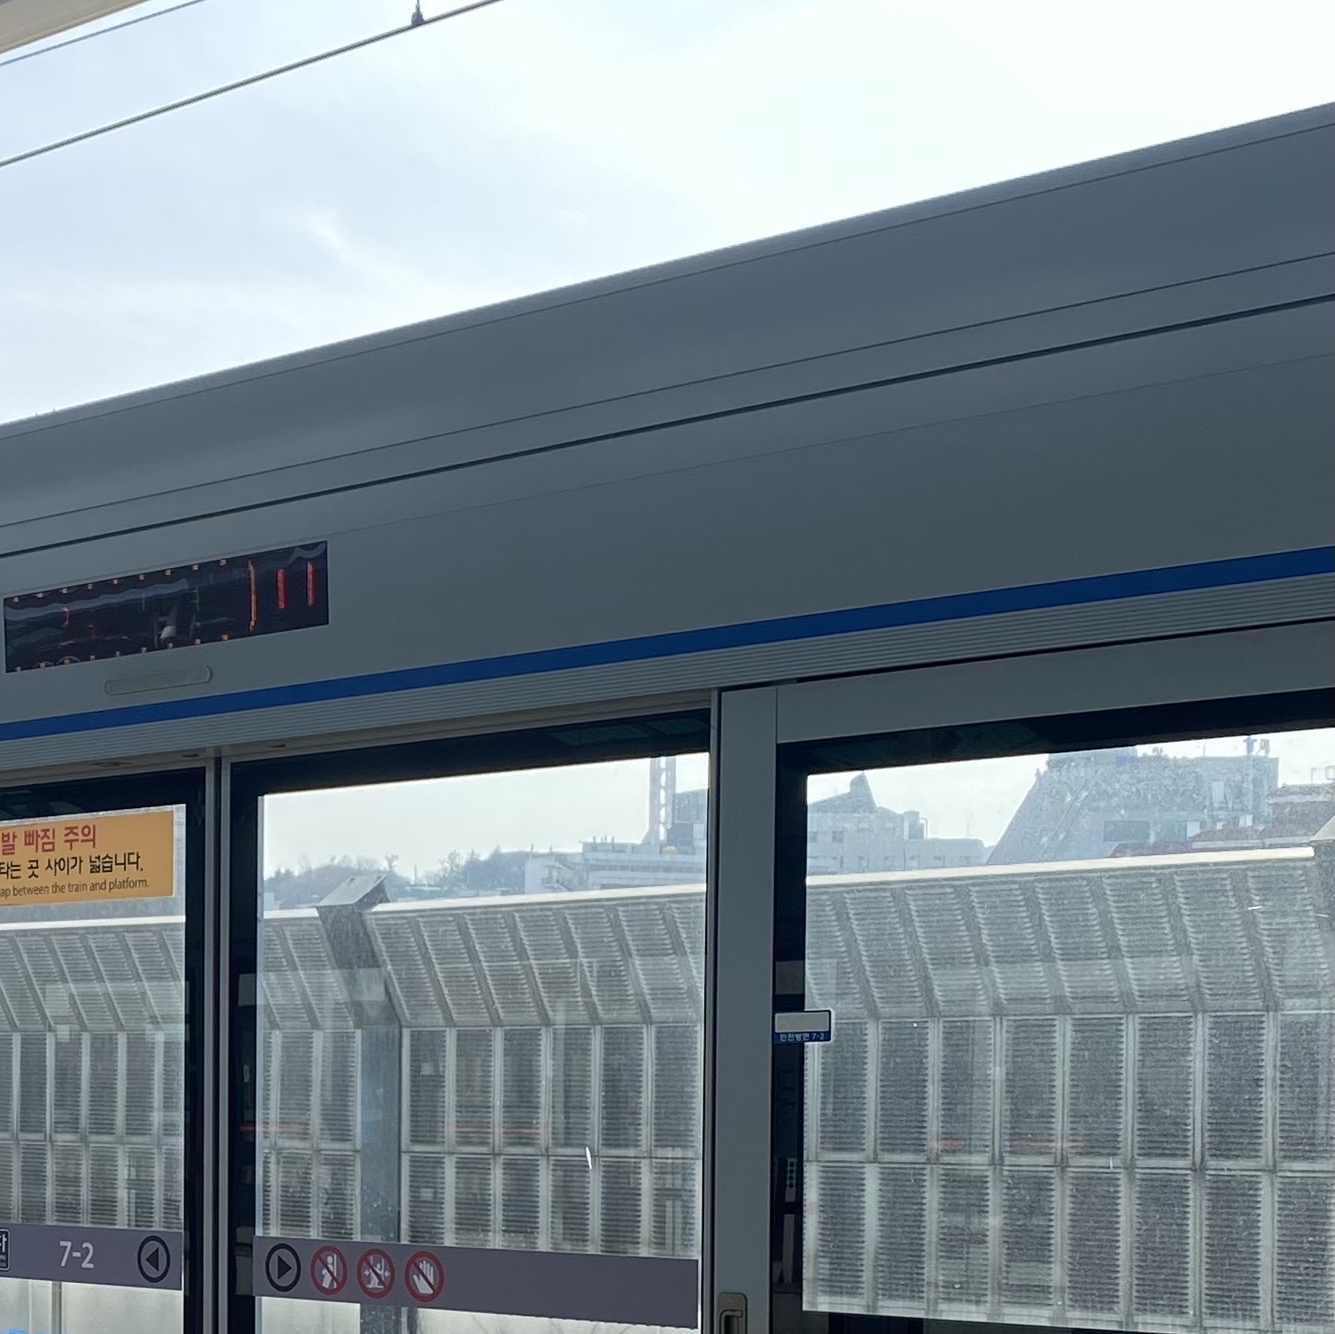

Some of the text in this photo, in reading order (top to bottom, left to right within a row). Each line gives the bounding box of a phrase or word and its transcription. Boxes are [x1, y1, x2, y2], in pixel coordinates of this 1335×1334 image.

[1, 824, 97, 856] 발 빠짐 주의
[27, 859, 40, 879] 곳
[45, 856, 83, 877] 사이가
[89, 851, 144, 874] 넓습니다.
[13, 883, 50, 898] between
[51, 882, 66, 895] the
[67, 881, 88, 894] train
[89, 880, 107, 893] and
[108, 877, 150, 893] platform.
[59, 1240, 95, 1269] 7-2
